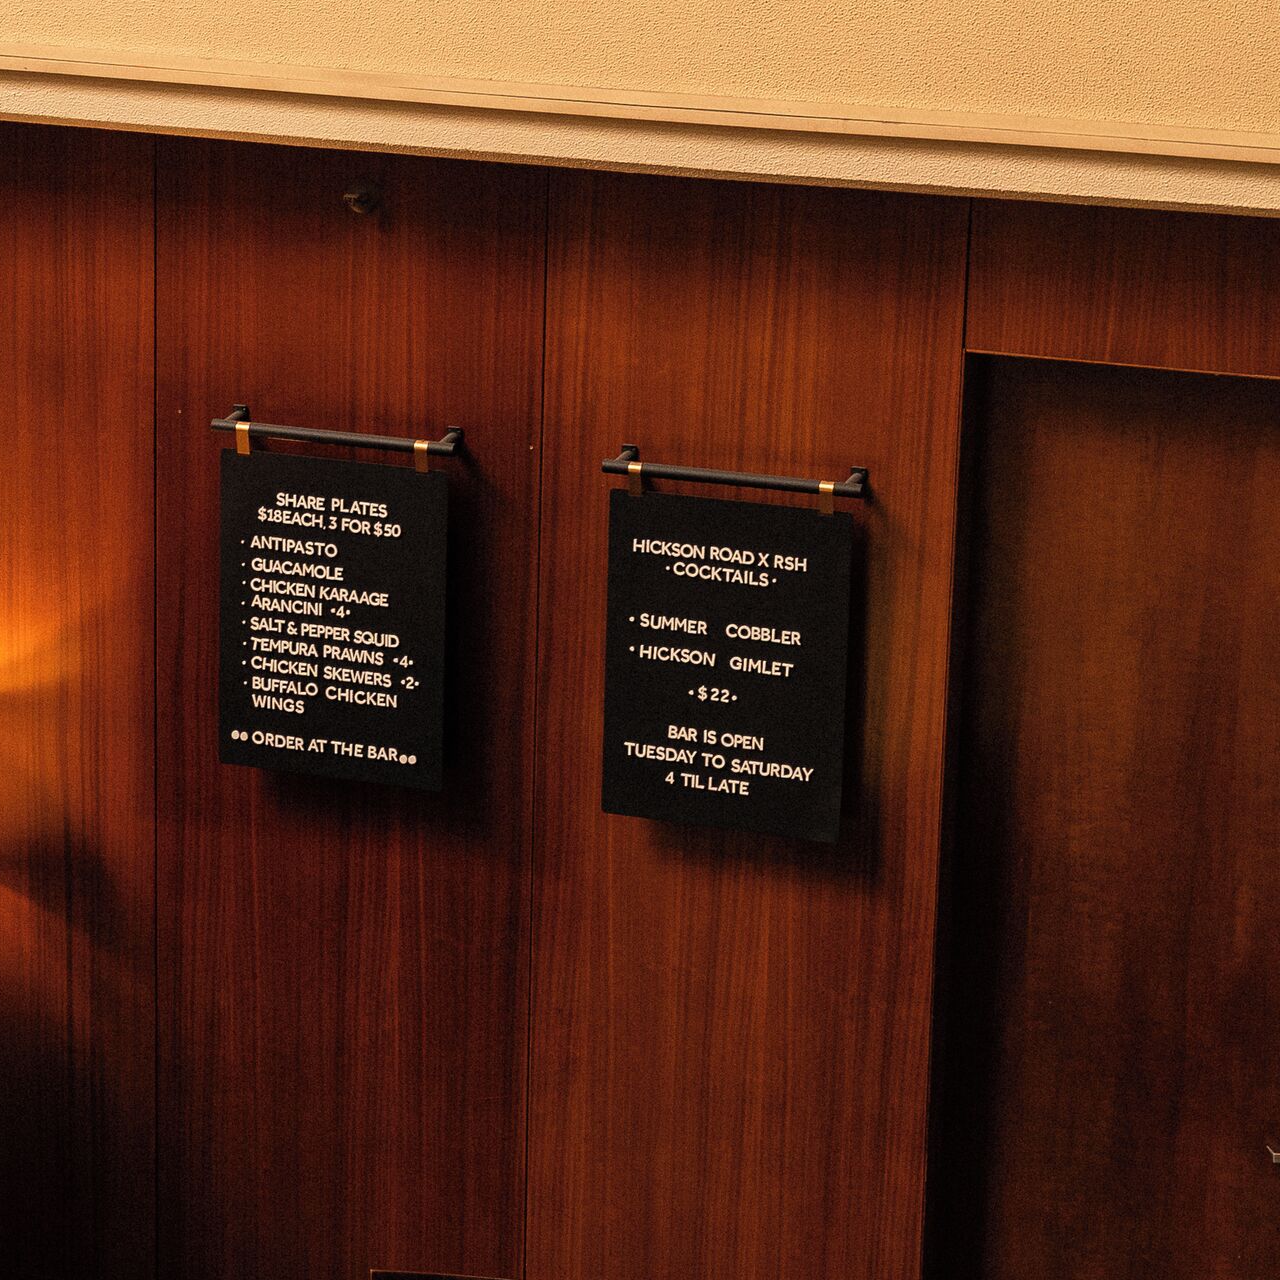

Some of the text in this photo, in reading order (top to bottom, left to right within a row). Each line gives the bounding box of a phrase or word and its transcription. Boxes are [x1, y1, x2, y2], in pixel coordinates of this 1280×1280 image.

[276, 492, 388, 518] SHARE PLATES
[329, 516, 337, 530] 3
[341, 518, 371, 535] FOR
[373, 521, 402, 538] $50
[250, 535, 338, 558] ANTIPASTO
[633, 539, 807, 572] HICKSON ROAD X RSH
[251, 557, 344, 581] GUACAMOLE
[250, 578, 389, 608] CHICKEN KARAAGE
[251, 595, 322, 616] ARANCINI
[250, 617, 400, 648] SALT & PEPPER SQUID
[640, 613, 801, 646] SUMMER COBBLER
[251, 637, 318, 658] TEMPURA
[323, 645, 384, 666] PRAWNS
[640, 645, 794, 677] HICKSON GIMLET
[251, 656, 318, 677] CHICKEN
[323, 666, 392, 687] SKEWERS
[252, 676, 398, 708] BUFFALO CHICKEN
[252, 694, 305, 714] WINGS
[252, 731, 398, 762] ORDER AT THE BAR
[668, 725, 764, 751] BAR IS OPEN
[624, 742, 814, 782] TUESDAY TO SATURDAY
[665, 772, 749, 796] 4 TIL LATE
